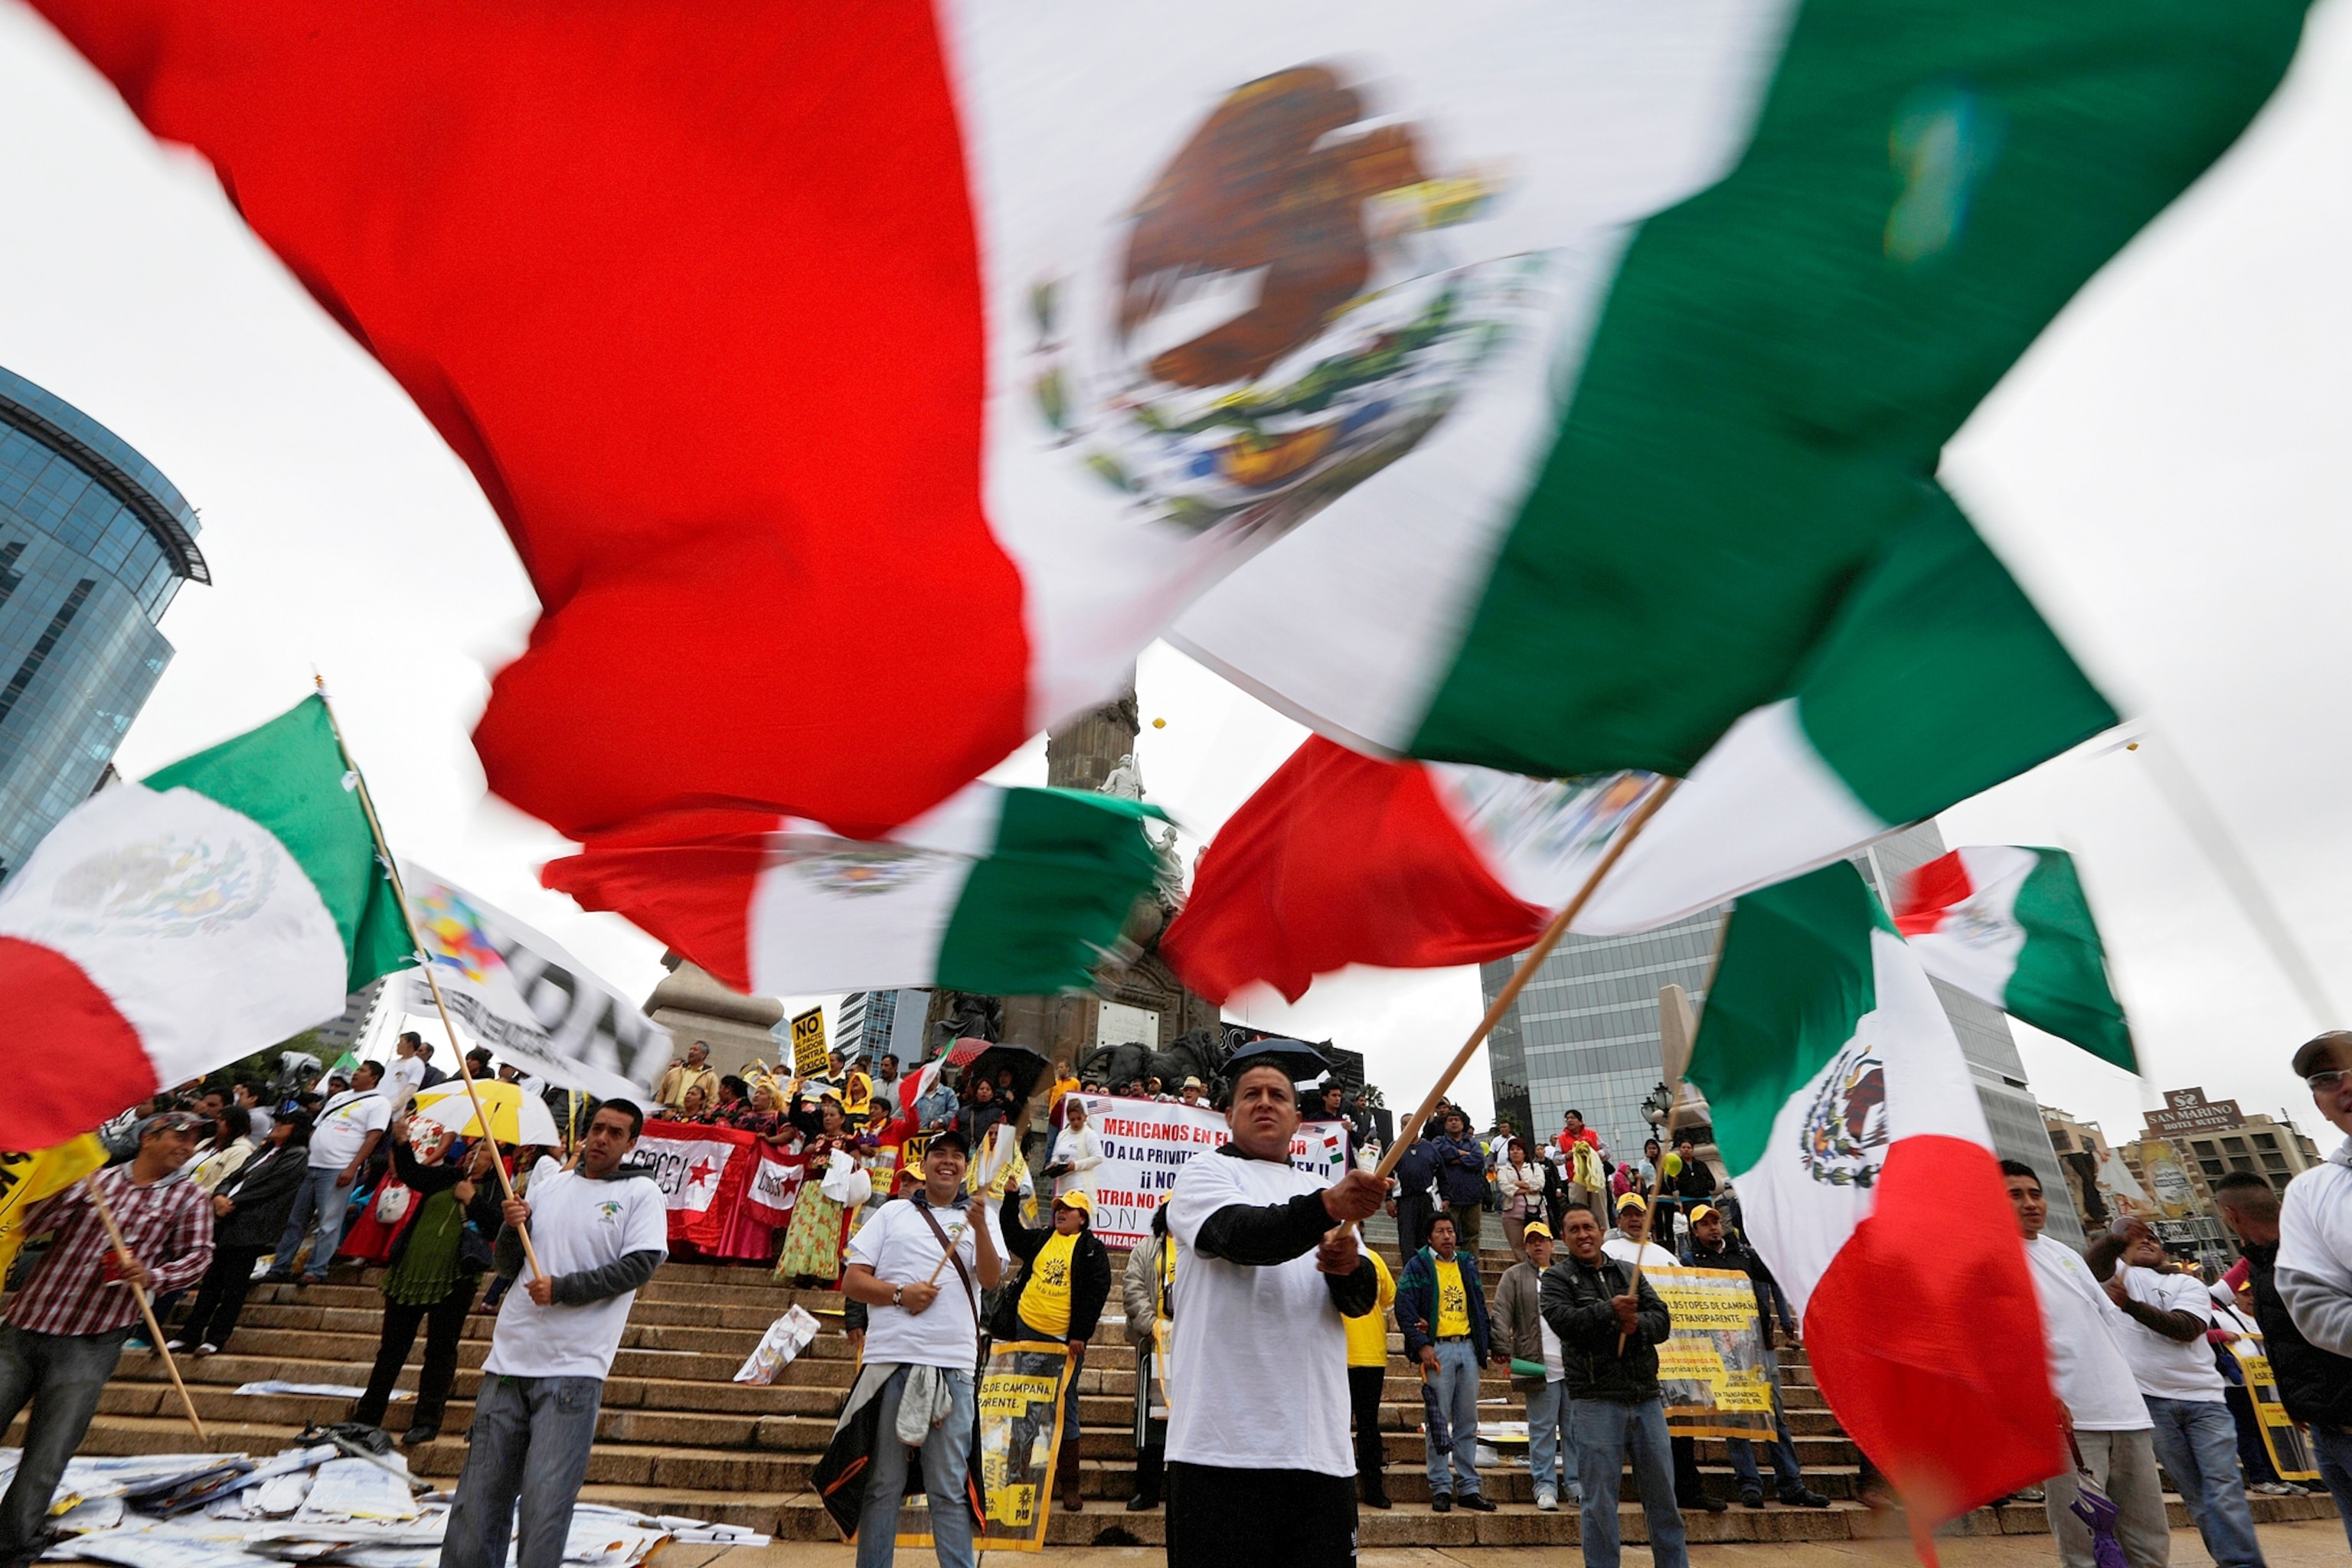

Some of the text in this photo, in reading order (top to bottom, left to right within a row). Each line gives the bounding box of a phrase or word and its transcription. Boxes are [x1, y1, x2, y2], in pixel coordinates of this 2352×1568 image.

[796, 1016, 818, 1040] NO
[803, 1032, 822, 1044] PACTO
[795, 1039, 824, 1056] TRAIDOR
[796, 1047, 825, 1064] CONTRA
[2148, 1104, 2233, 1124] SAN MARINO
[1103, 1118, 1189, 1142] MEXICANOS
[1193, 1129, 1210, 1144] EN
[2164, 1116, 2229, 1131] HOTEL SUITES
[1118, 1146, 1125, 1159] A
[1129, 1147, 1144, 1161] LA
[1155, 1171, 1176, 1189] NO
[1137, 1193, 1155, 1209] NO
[1684, 1302, 1709, 1310] TOPES
[1711, 1302, 1720, 1310] DE
[990, 1383, 1000, 1392] DE
